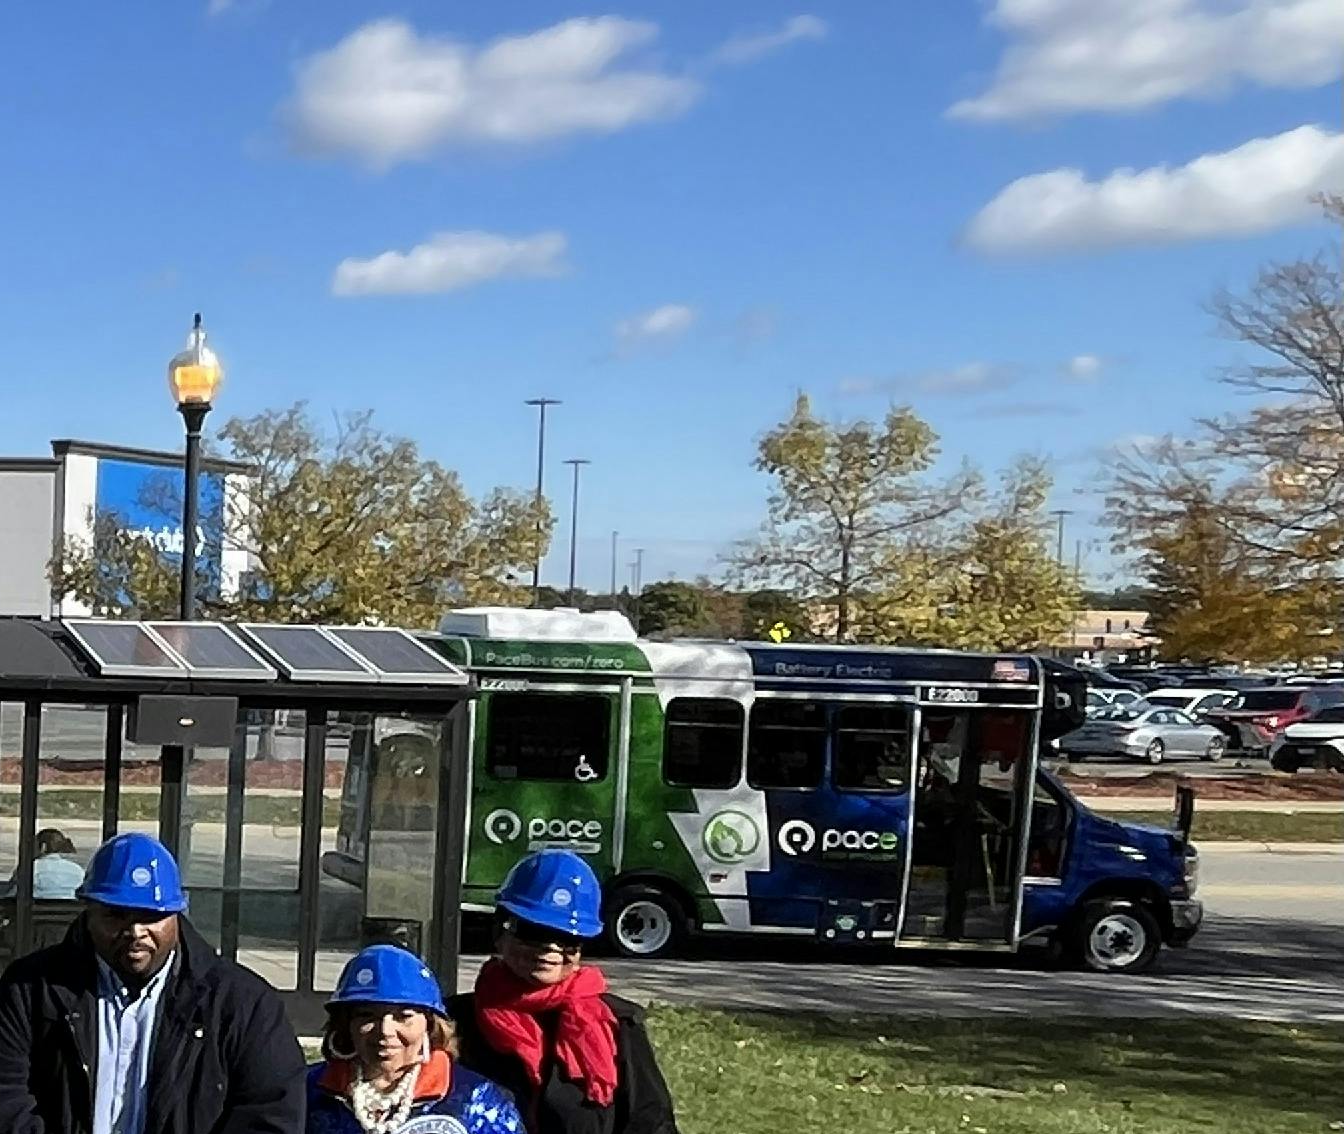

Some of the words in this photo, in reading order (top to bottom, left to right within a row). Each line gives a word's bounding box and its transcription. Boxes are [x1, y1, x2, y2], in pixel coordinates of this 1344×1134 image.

[775, 661, 833, 678] Battery
[836, 661, 892, 678] Electric
[528, 817, 602, 840] pace
[822, 828, 898, 851] pace
